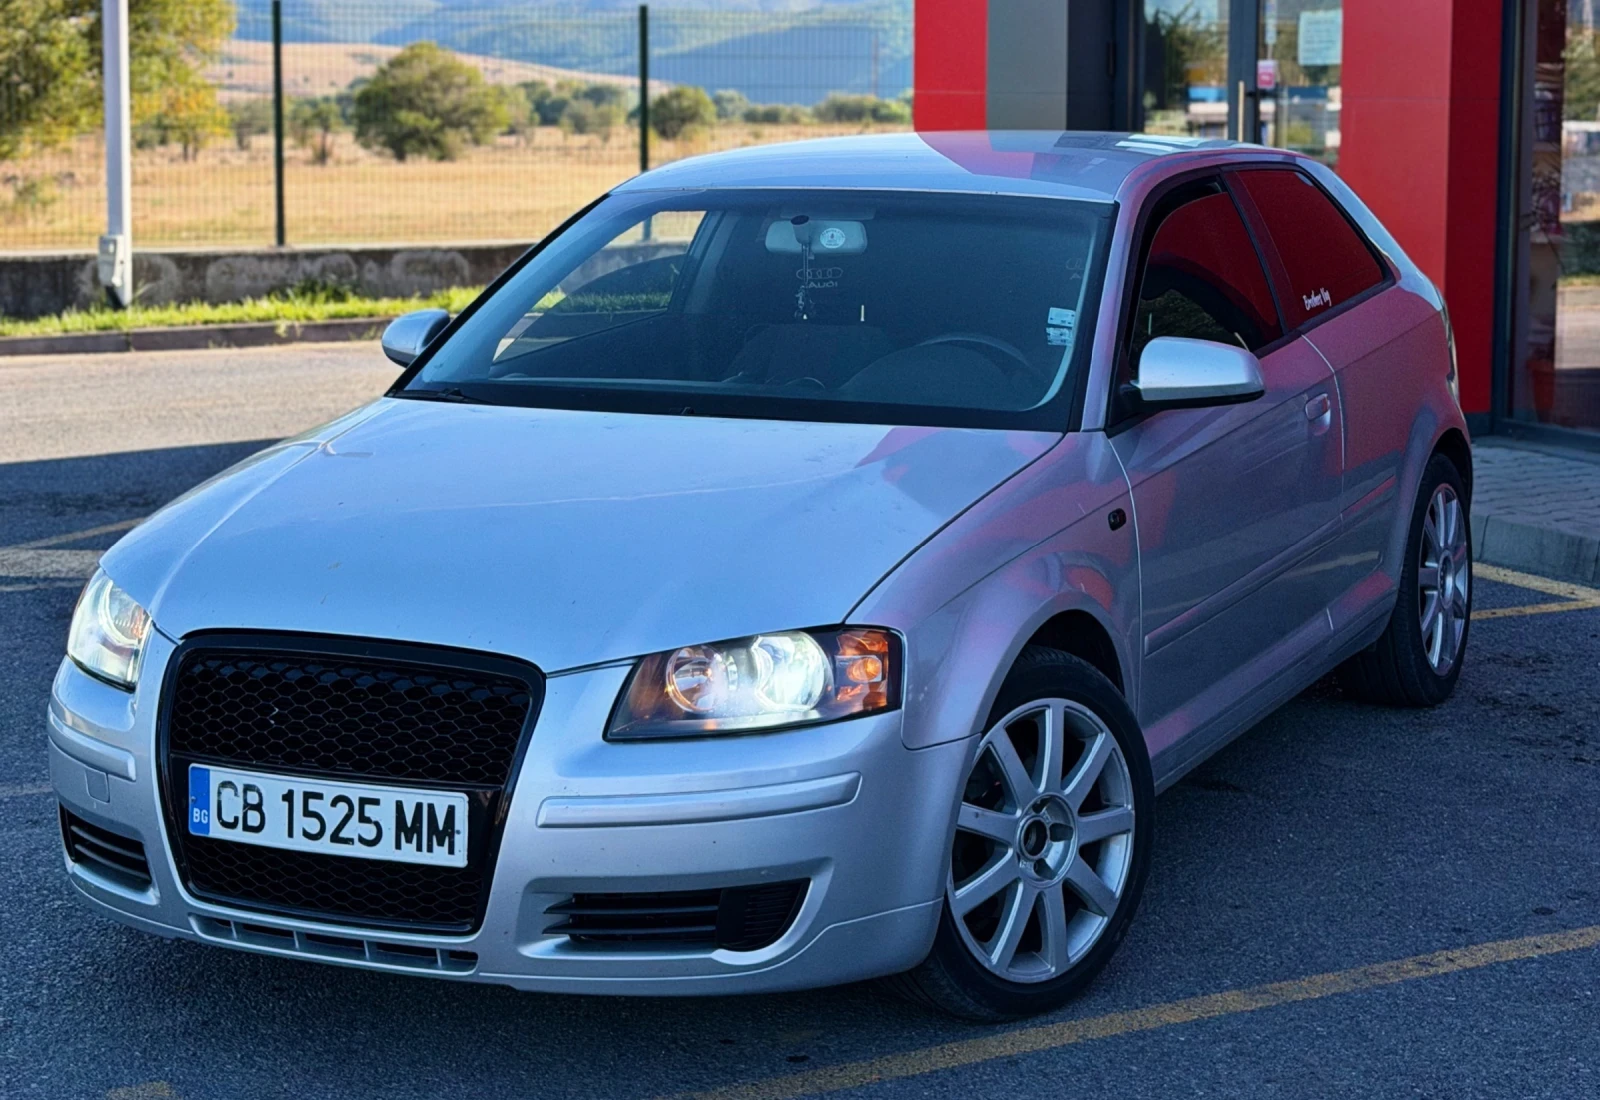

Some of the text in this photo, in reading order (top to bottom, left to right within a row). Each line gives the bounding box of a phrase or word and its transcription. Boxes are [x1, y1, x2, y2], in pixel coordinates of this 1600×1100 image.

[193, 807, 209, 824] BG
[216, 780, 456, 856] CB 1525 MM
